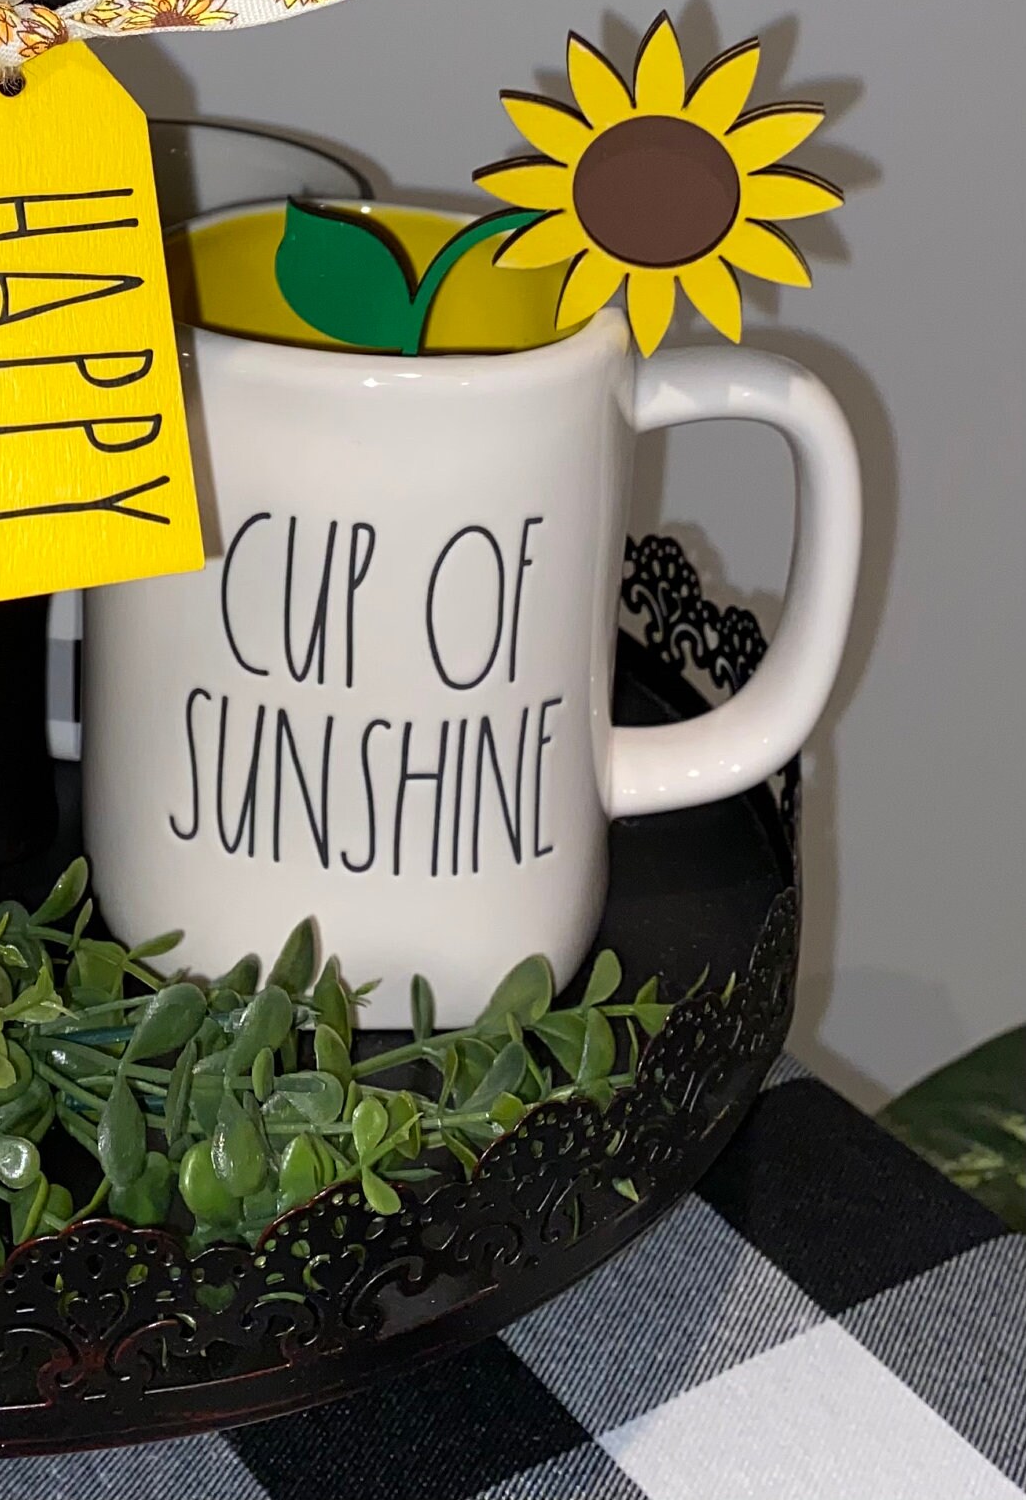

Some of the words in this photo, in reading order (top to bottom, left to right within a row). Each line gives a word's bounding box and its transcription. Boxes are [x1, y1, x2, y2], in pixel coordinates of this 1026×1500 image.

[221, 511, 377, 689] CUP
[426, 516, 544, 691] OF
[169, 687, 564, 878] SUNSHINE
